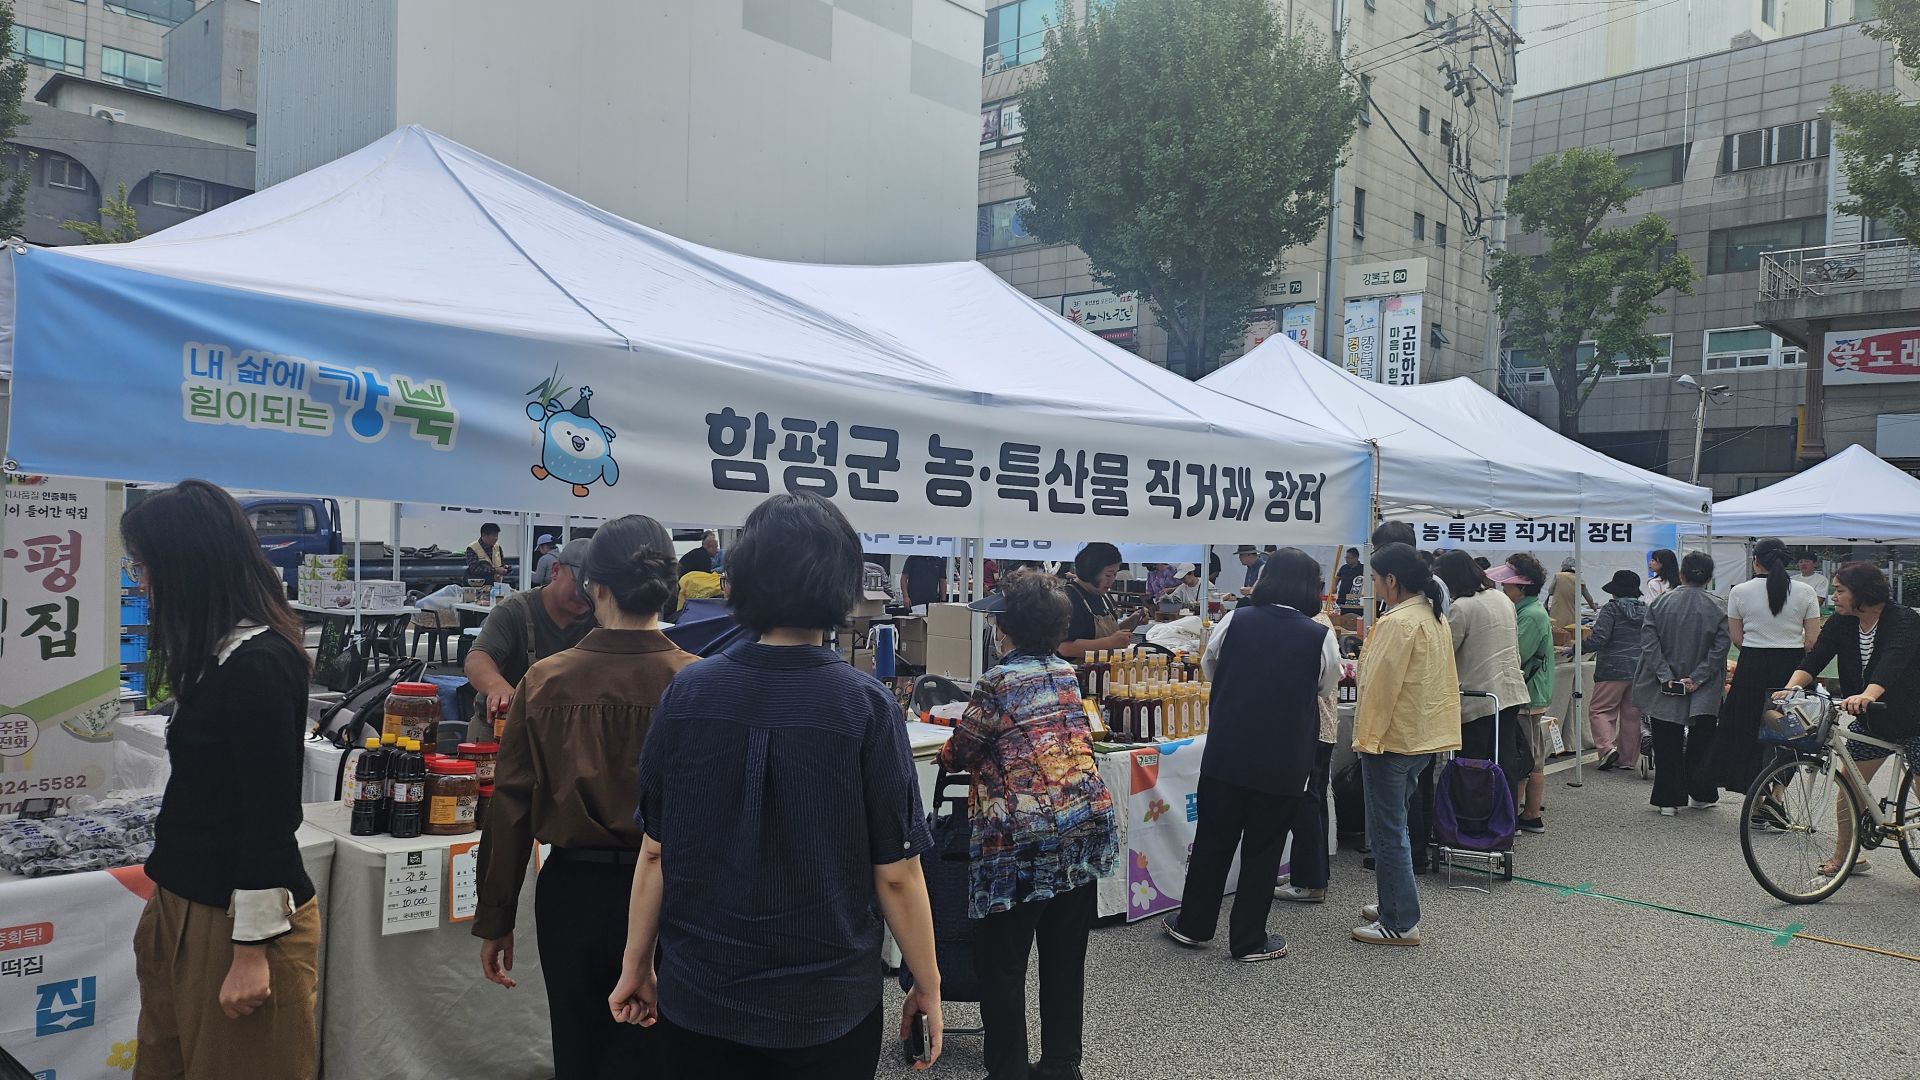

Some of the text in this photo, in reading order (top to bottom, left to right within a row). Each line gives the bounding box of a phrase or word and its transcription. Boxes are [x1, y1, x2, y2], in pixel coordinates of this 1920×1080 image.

[1290, 283, 1301, 292] 79
[1363, 271, 1406, 286] 강북구 80
[1389, 327, 1400, 363] 마음이
[190, 348, 305, 391] 내 삶에
[189, 385, 329, 431] 힘이되는
[318, 365, 455, 446] 강북
[705, 406, 1327, 524] 함평군 농·특산물 직거래 장터
[25, 504, 62, 518] 들어간
[66, 506, 88, 519] 떡집
[42, 491, 77, 501] 인증획득
[1422, 522, 1633, 543] 농·특산물 직거래 장터
[4, 529, 82, 593] 평
[1, 595, 80, 661] 집
[1, 954, 44, 978] 떡집
